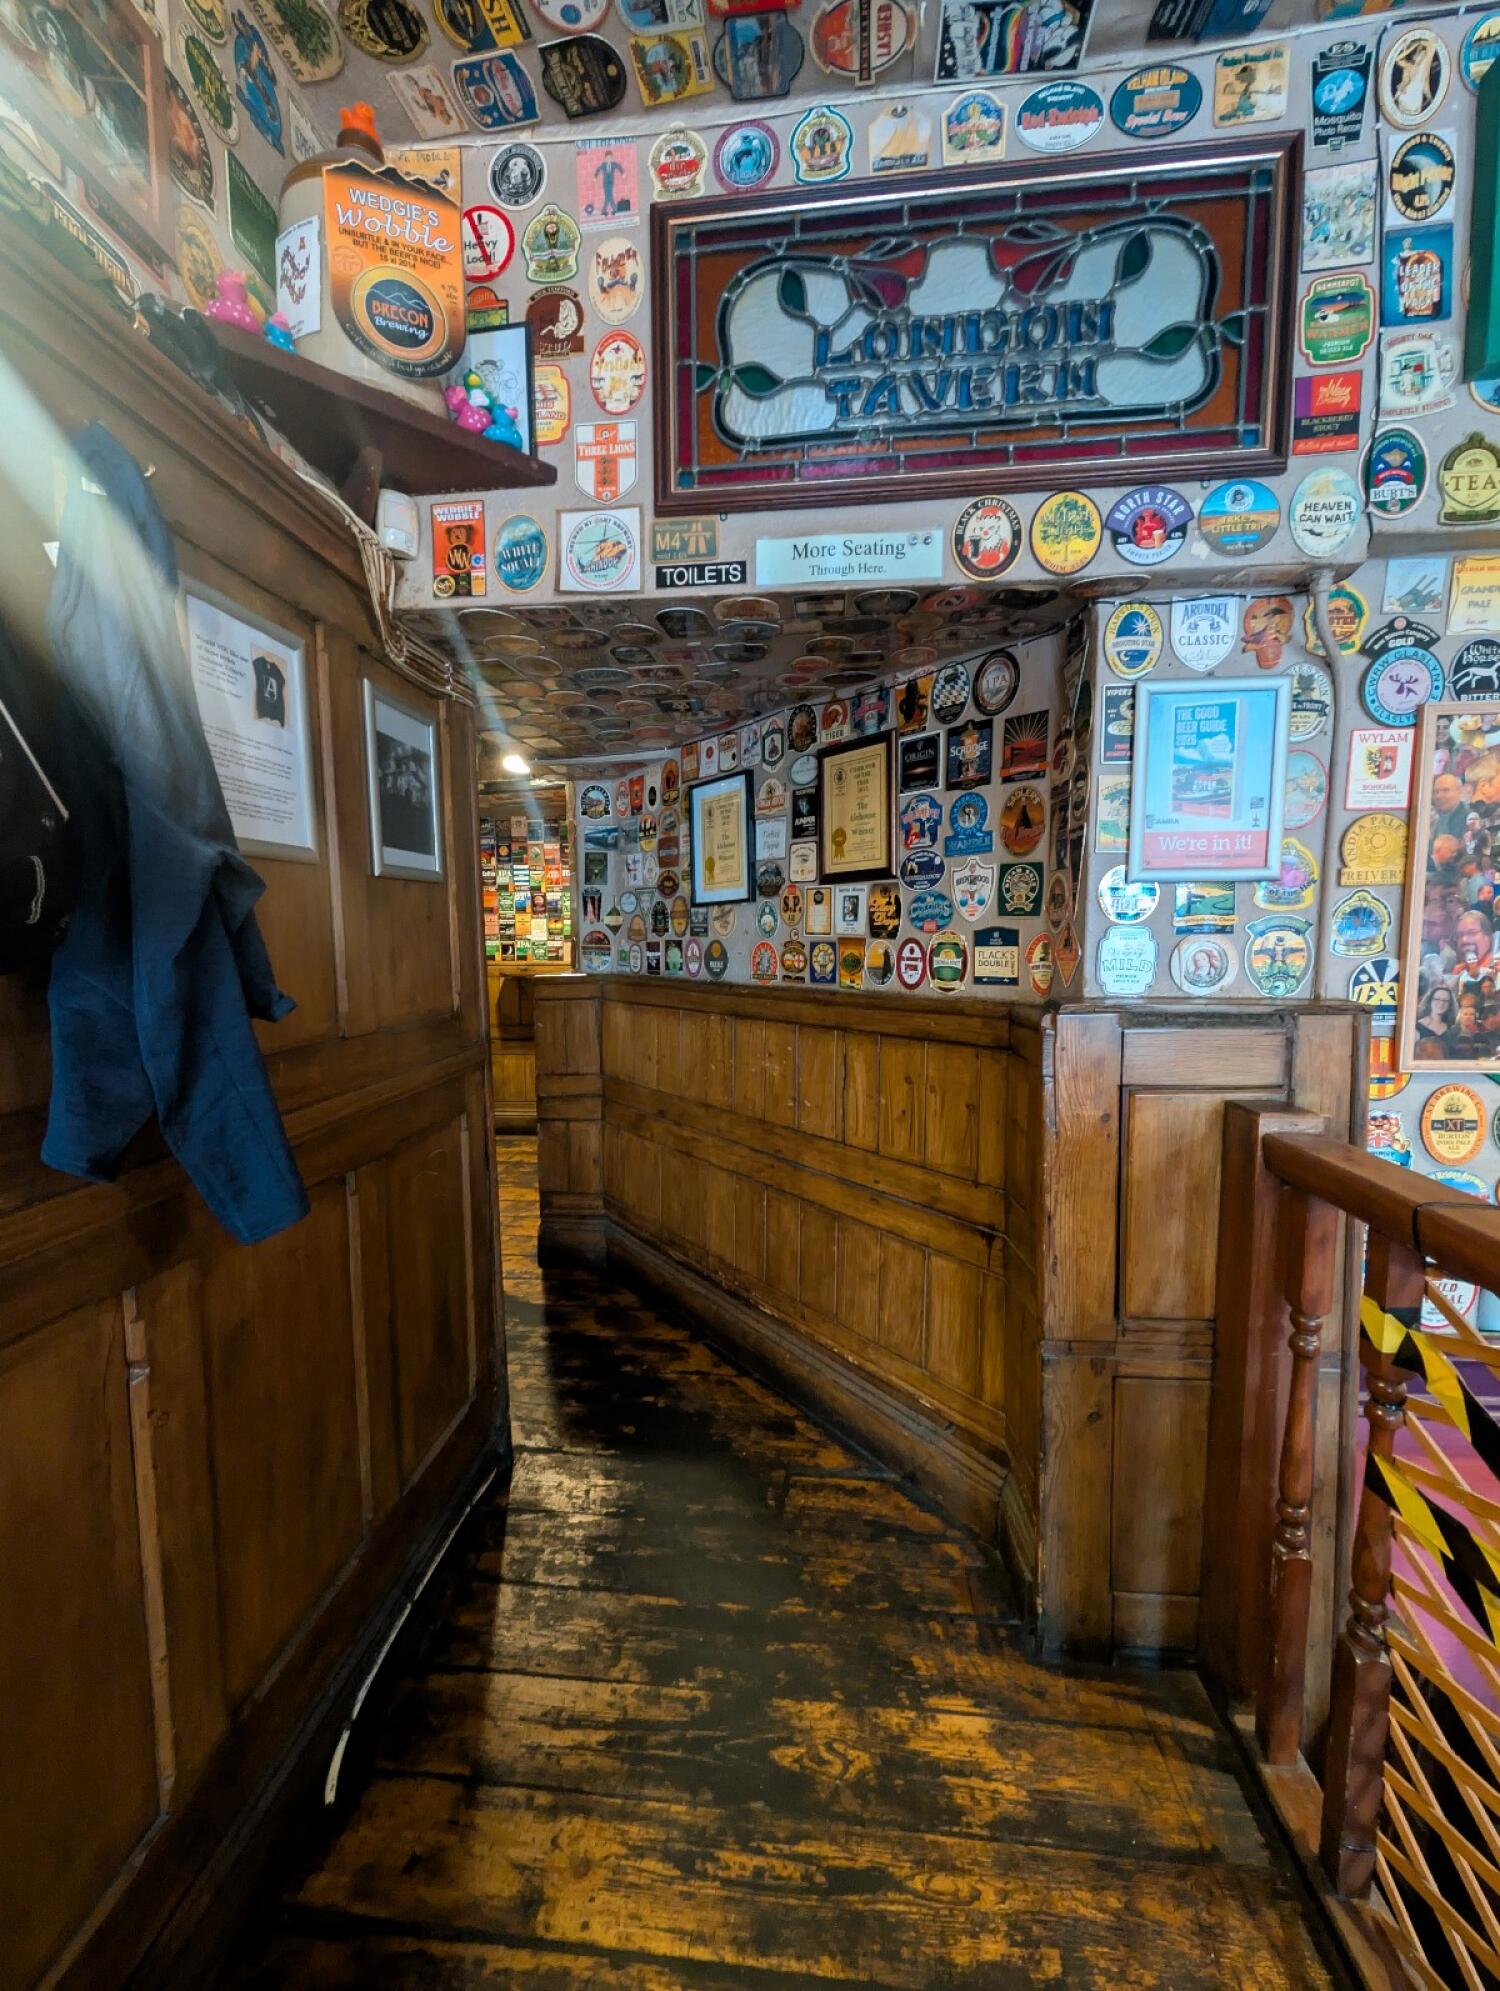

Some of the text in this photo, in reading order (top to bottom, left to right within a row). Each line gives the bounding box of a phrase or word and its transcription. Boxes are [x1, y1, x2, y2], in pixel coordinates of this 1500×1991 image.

[281, 49, 305, 77] OAK
[1314, 111, 1362, 126] Mosquito
[349, 187, 440, 227] WEDGIE'S
[335, 202, 456, 253] Wobble
[464, 239, 498, 252] Heavy
[371, 300, 429, 328] BRECON
[374, 315, 430, 340] Brewing
[813, 299, 1117, 369] LONDON
[827, 356, 1099, 419] TAVERN
[1312, 424, 1341, 433] STOUT
[578, 442, 636, 457] THREE LIONS
[1450, 474, 1497, 493] TEA
[1113, 490, 1186, 521] NORTH STAR
[1304, 500, 1352, 513] HEAVEN
[978, 498, 1021, 531] CHRISTMAS
[1300, 514, 1322, 524] CAN
[1212, 522, 1267, 534] LITTLE TRIP
[501, 542, 540, 559] WHITE
[656, 532, 681, 552] M4
[792, 539, 906, 560] More Seating
[662, 564, 742, 586] TOILETS
[809, 562, 888, 576] Through Here.
[1182, 601, 1230, 626] ARUNDEL
[1178, 634, 1230, 647] CLASSIC
[1388, 636, 1415, 648] GOLD
[985, 673, 1010, 690] IPA
[1367, 649, 1441, 697] CWRW GLASLYN
[1177, 706, 1220, 721] THE GOOD
[1374, 705, 1416, 723] GLASLY
[824, 729, 844, 740] TIGER
[1176, 719, 1228, 733] BEER GUIDE
[1358, 732, 1409, 744] WYLAM
[904, 748, 935, 763] ORIGIN
[950, 740, 989, 761] SCROOGE
[1159, 834, 1252, 851] We're in it!
[1346, 823, 1367, 866] INDIA
[977, 951, 1015, 961] FLACK'S
[978, 959, 1010, 968] DOUBLE
[1101, 958, 1154, 974] MILD
[1445, 1119, 1463, 1131] XT
